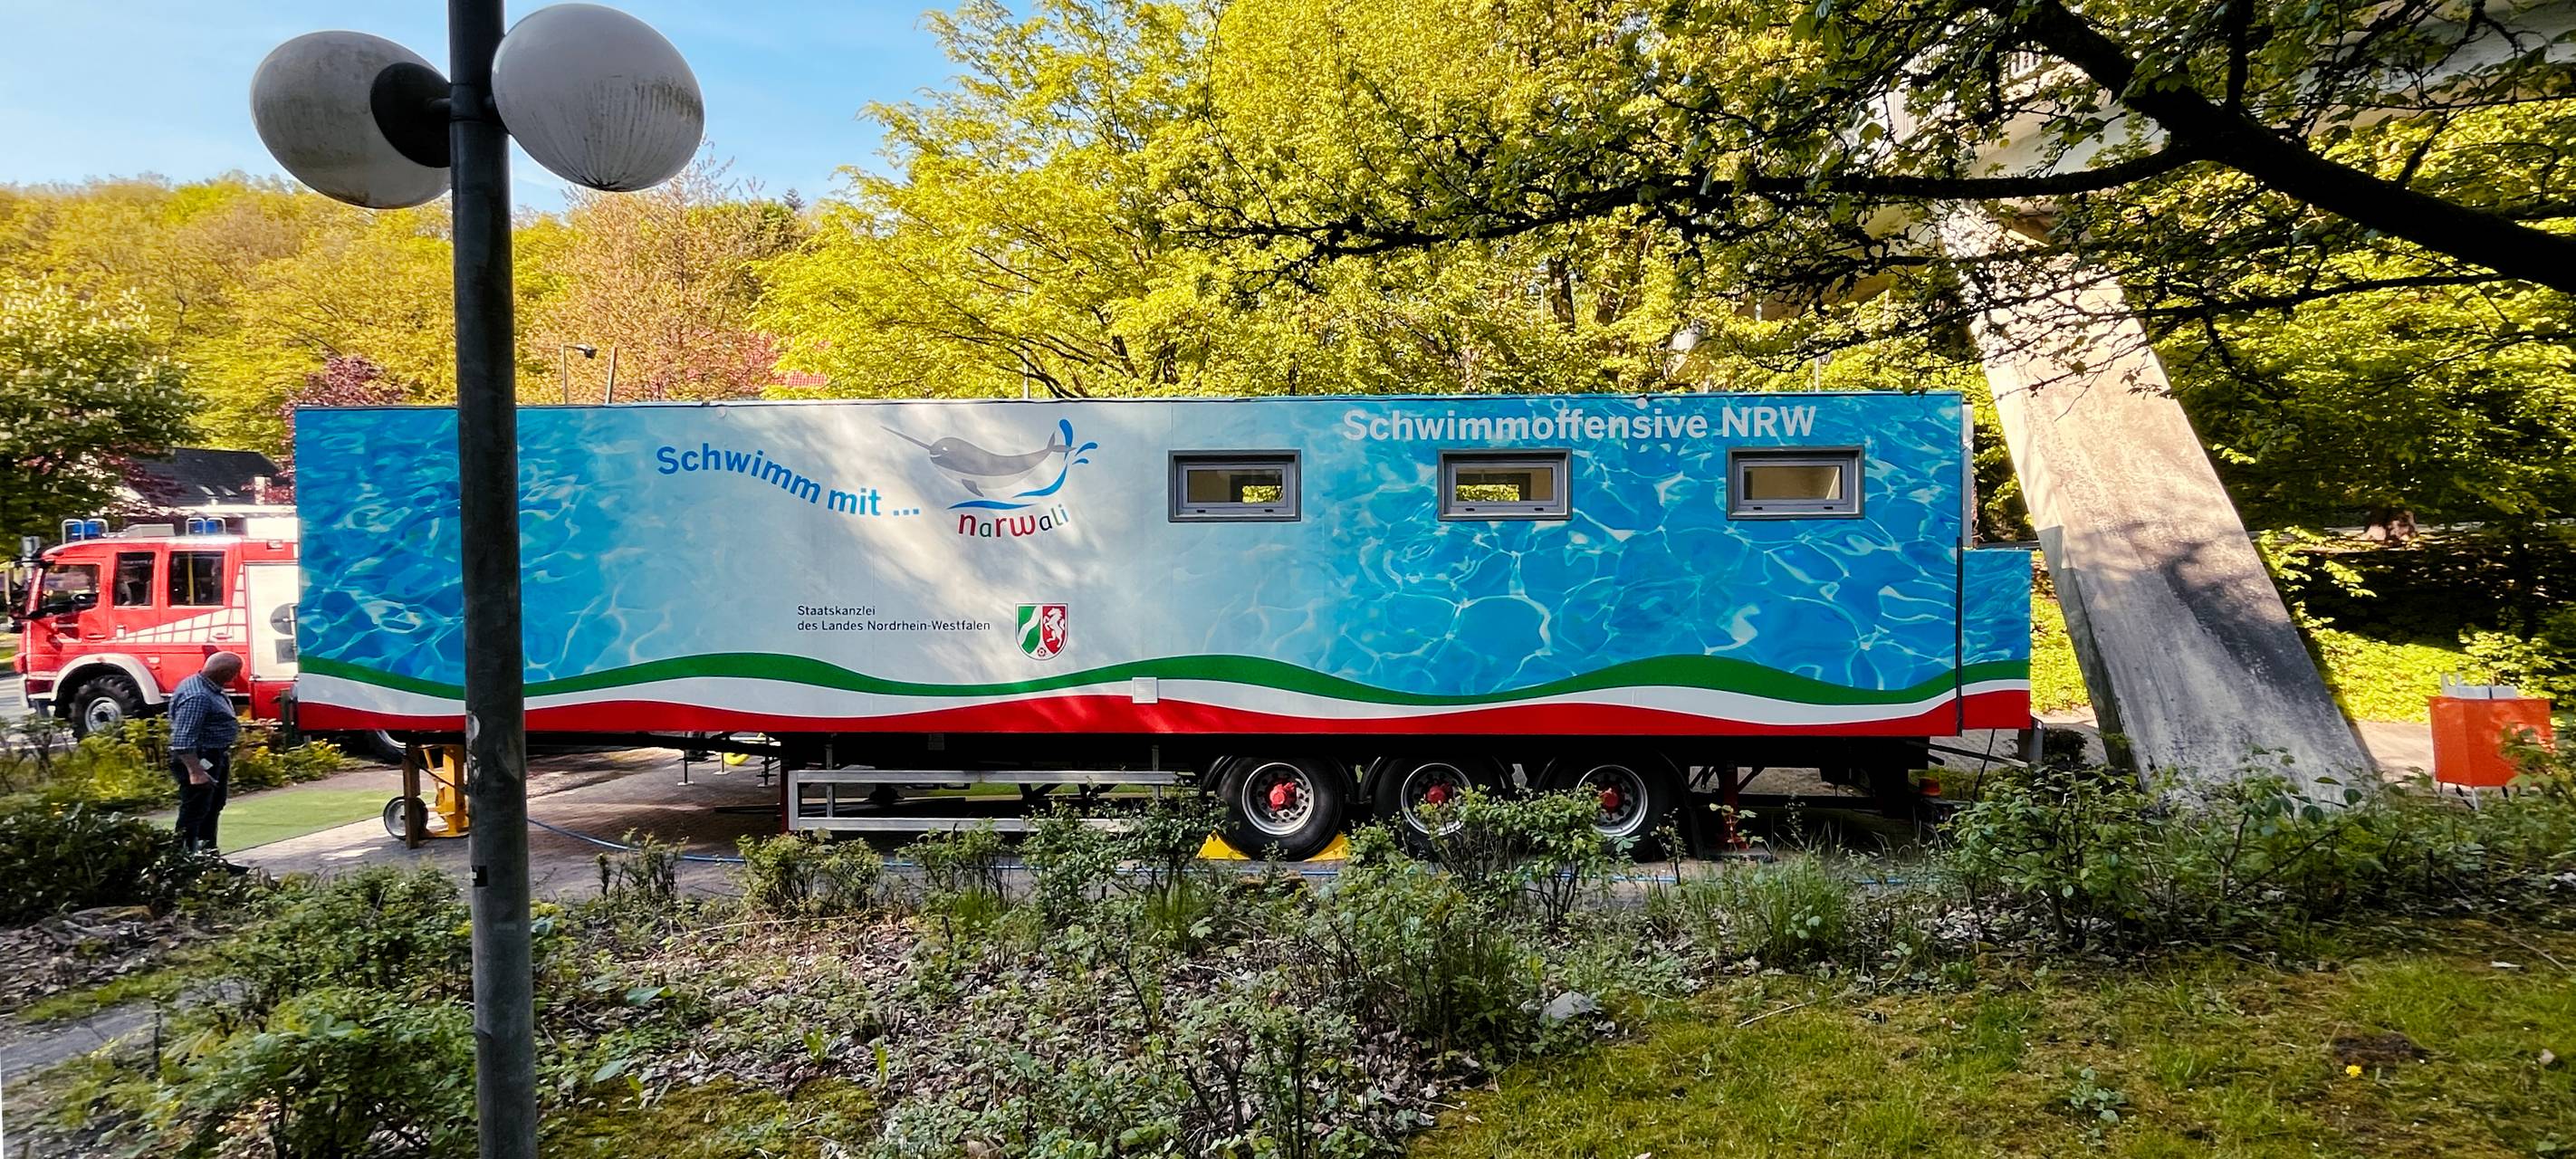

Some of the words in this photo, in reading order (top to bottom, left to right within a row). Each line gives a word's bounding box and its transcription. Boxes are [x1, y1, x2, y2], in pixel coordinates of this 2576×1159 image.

[1344, 408, 1708, 441] Schwimmoffensive
[1722, 406, 1816, 437] NRW
[656, 443, 820, 504] Schwimm
[828, 488, 881, 516] mit
[958, 503, 1068, 538] narwali
[797, 605, 876, 616] Staatskanzlei
[797, 620, 819, 631] des
[821, 620, 863, 631] Landes
[867, 620, 991, 631] Nordrhein-Westfalen
